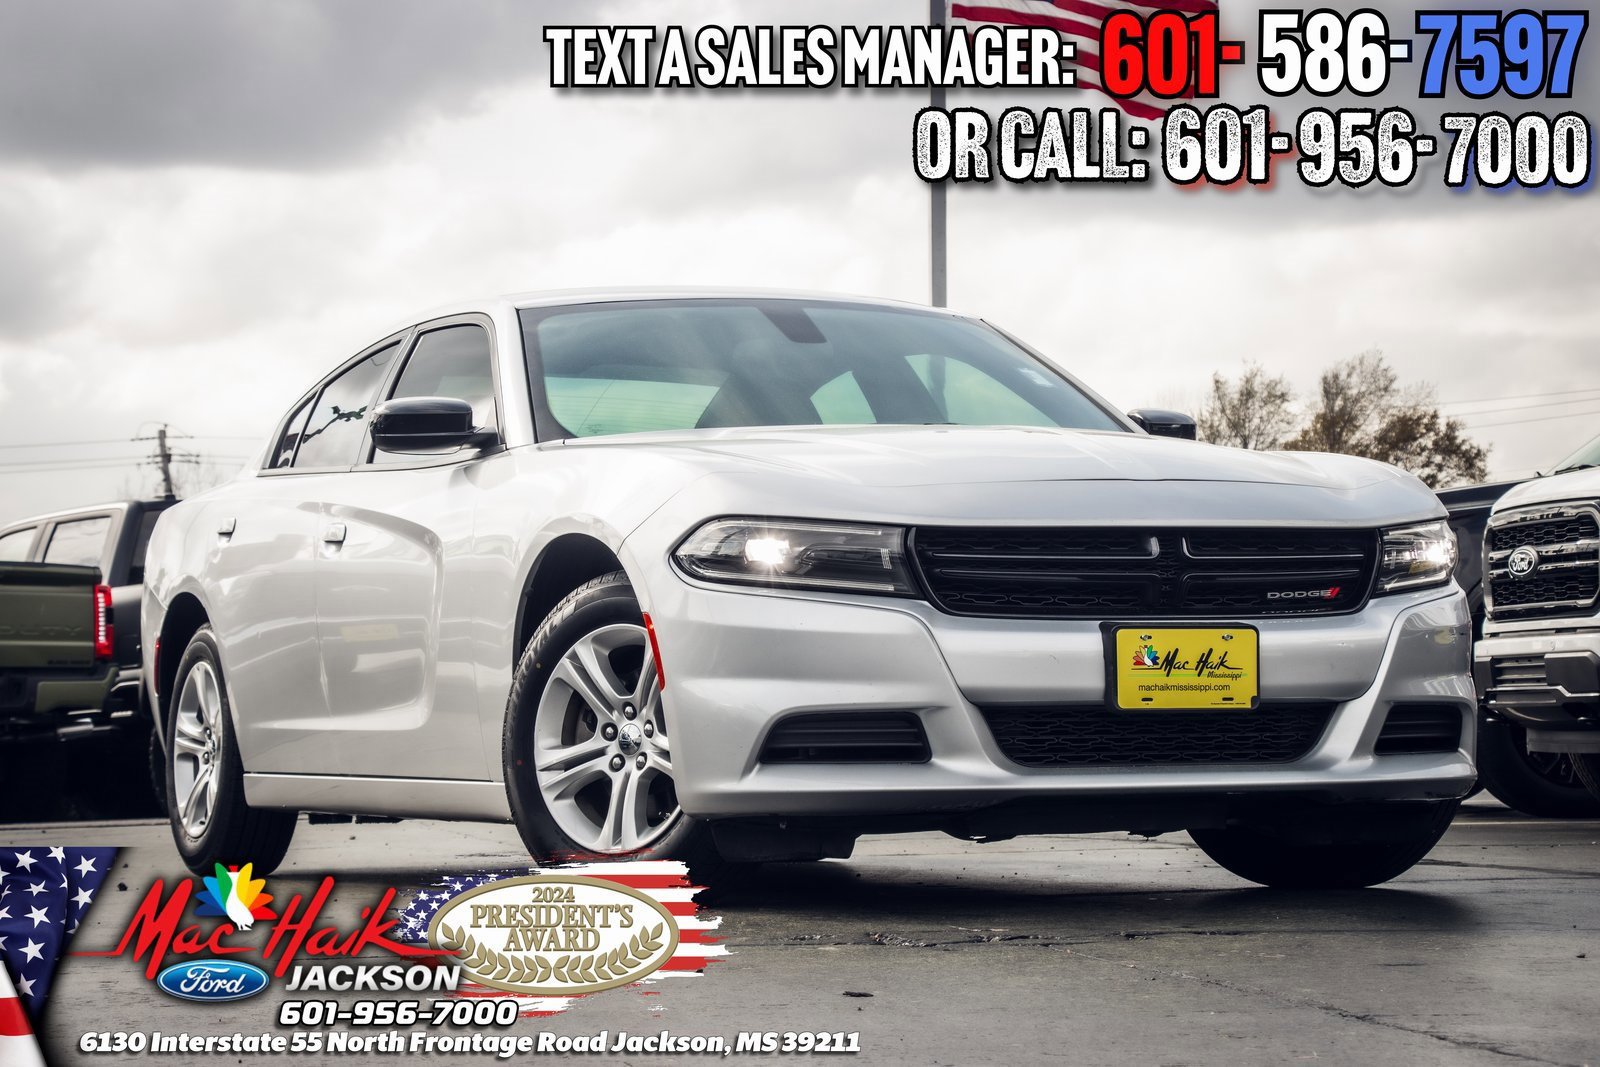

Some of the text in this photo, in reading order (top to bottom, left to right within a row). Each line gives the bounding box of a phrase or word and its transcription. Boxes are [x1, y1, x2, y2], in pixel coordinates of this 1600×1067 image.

[1267, 590, 1332, 599] DODGE
[1159, 648, 1236, 677] Mac Haik
[1206, 671, 1243, 681] Mississippi
[1138, 683, 1231, 692] machaikmississippi.com
